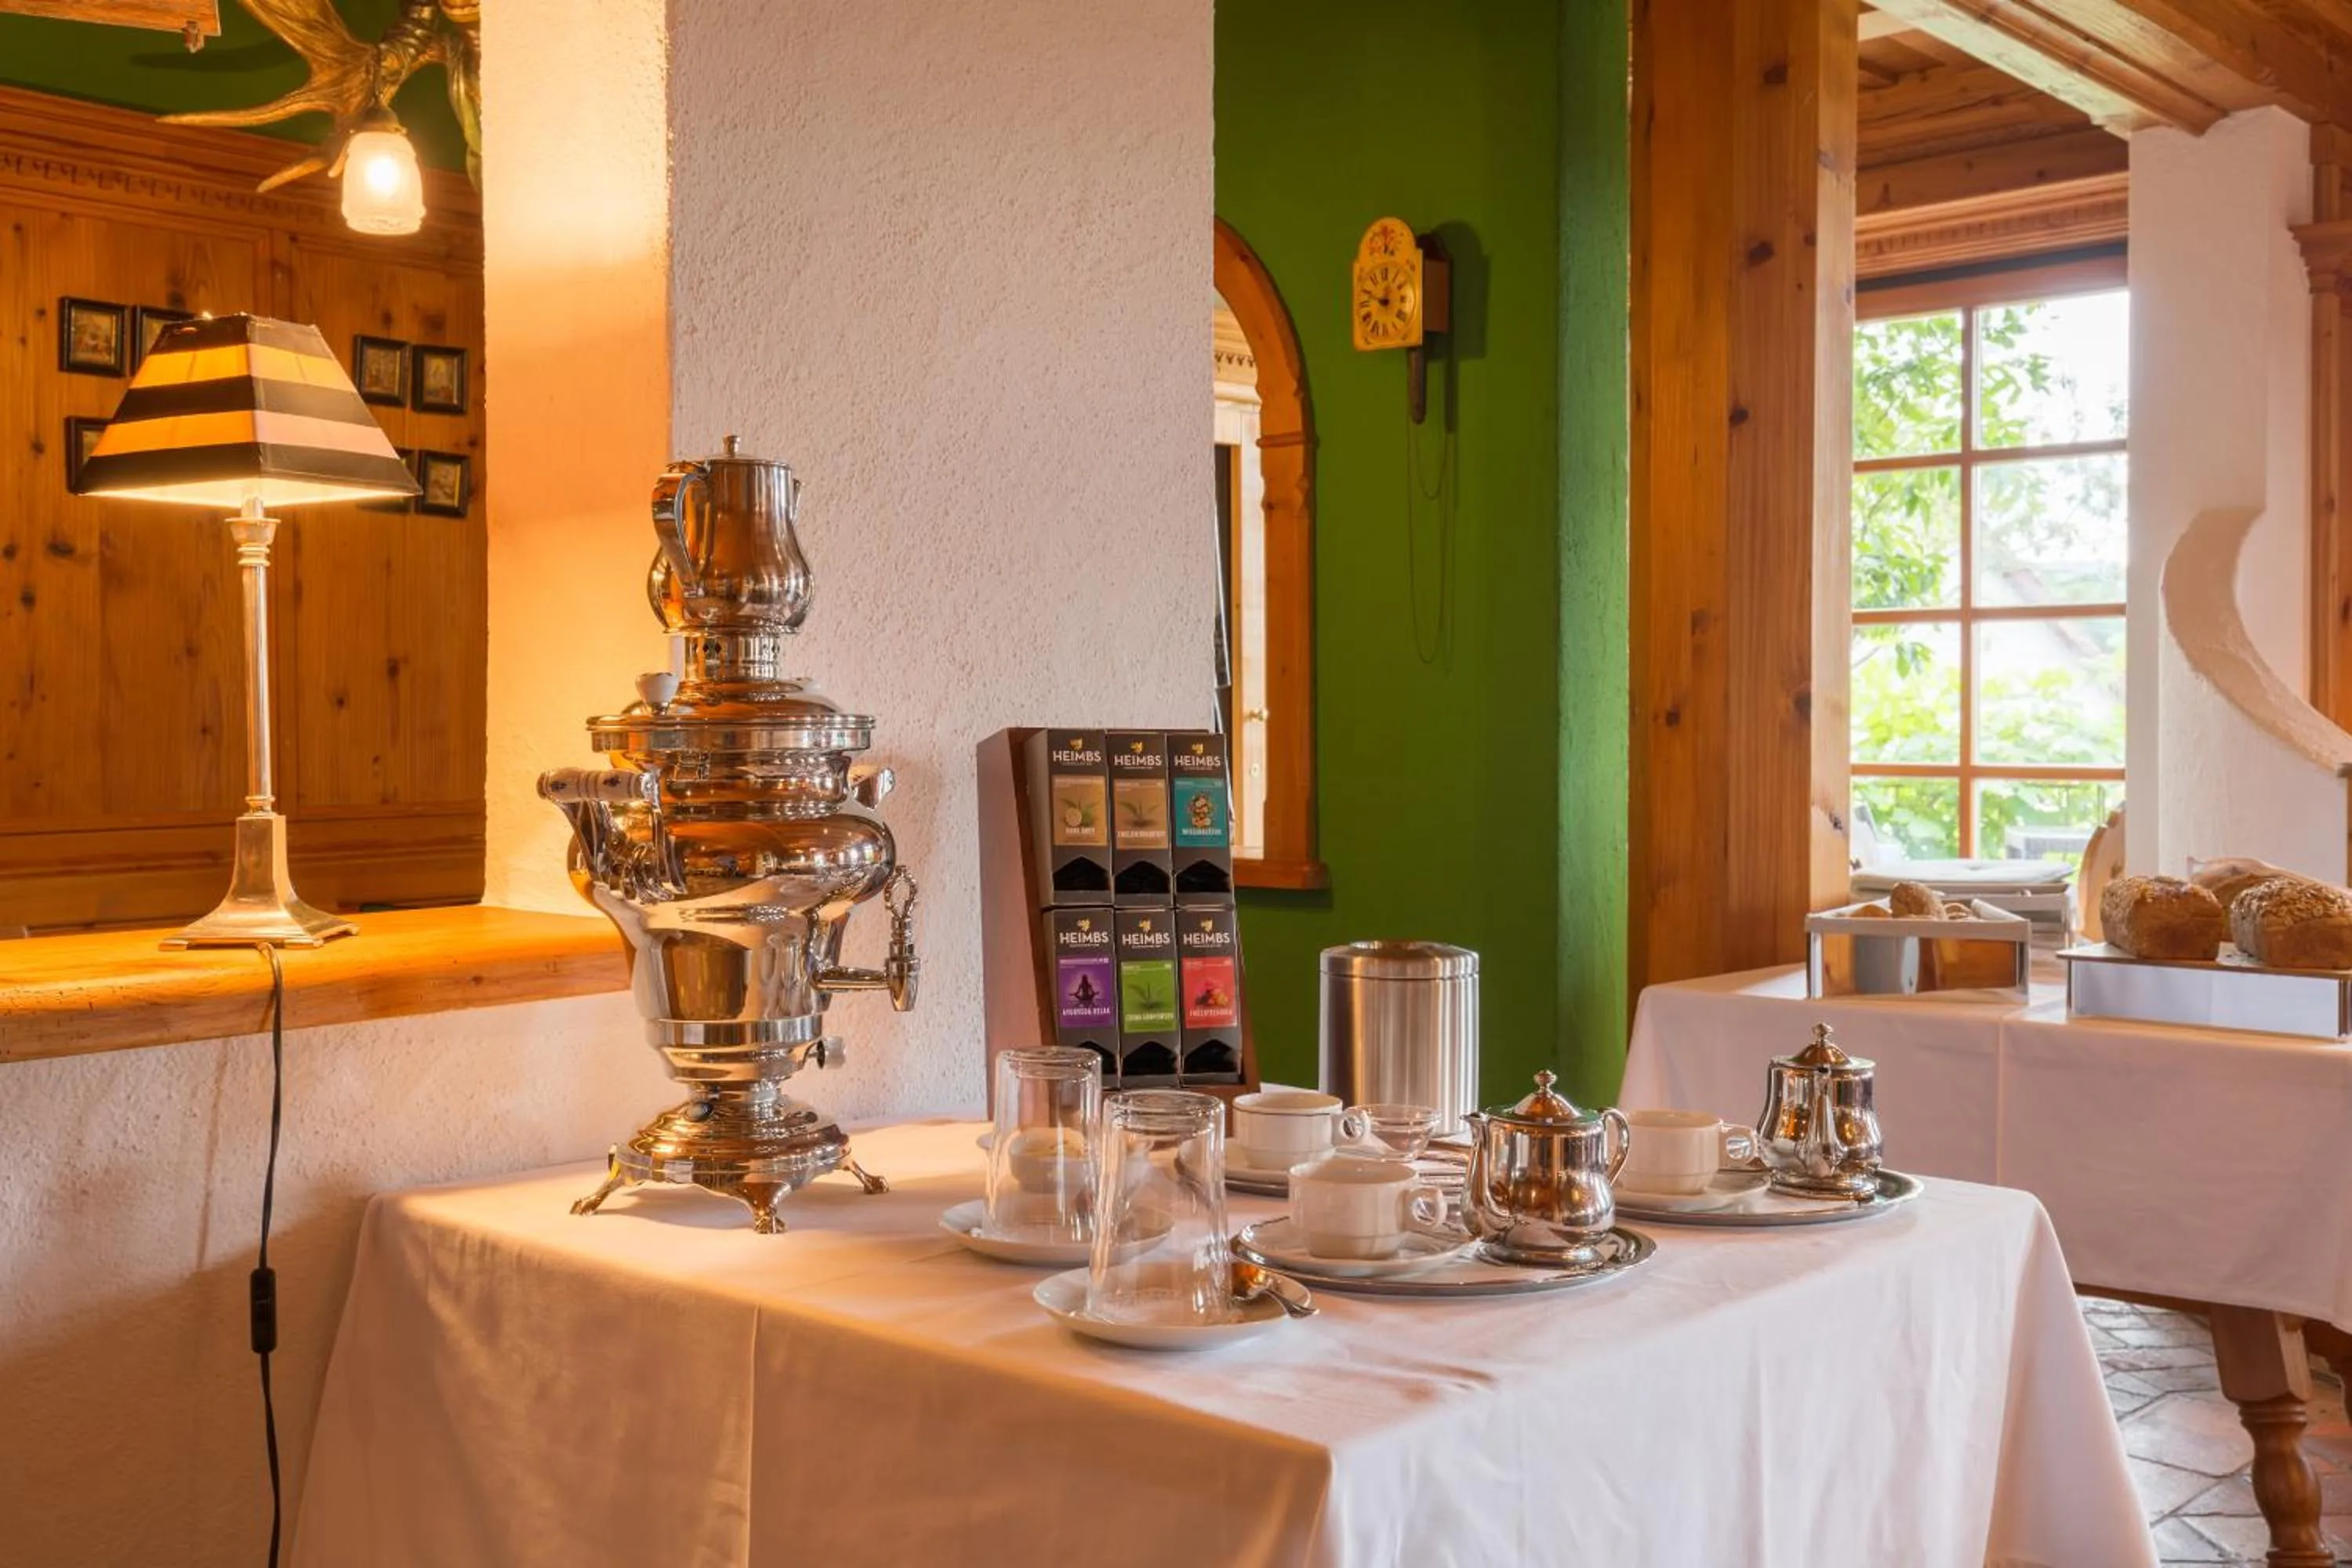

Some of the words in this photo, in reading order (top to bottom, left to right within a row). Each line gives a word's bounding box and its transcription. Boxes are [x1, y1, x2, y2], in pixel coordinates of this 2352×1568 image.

[1053, 750, 1102, 763] HEIMBS
[1114, 754, 1162, 767] HEIMBS
[1174, 755, 1221, 767] HEIMBS
[1059, 931, 1109, 944] HEIMBS
[1122, 932, 1171, 946] HEIMBS
[1183, 932, 1230, 945] HEIMBS
